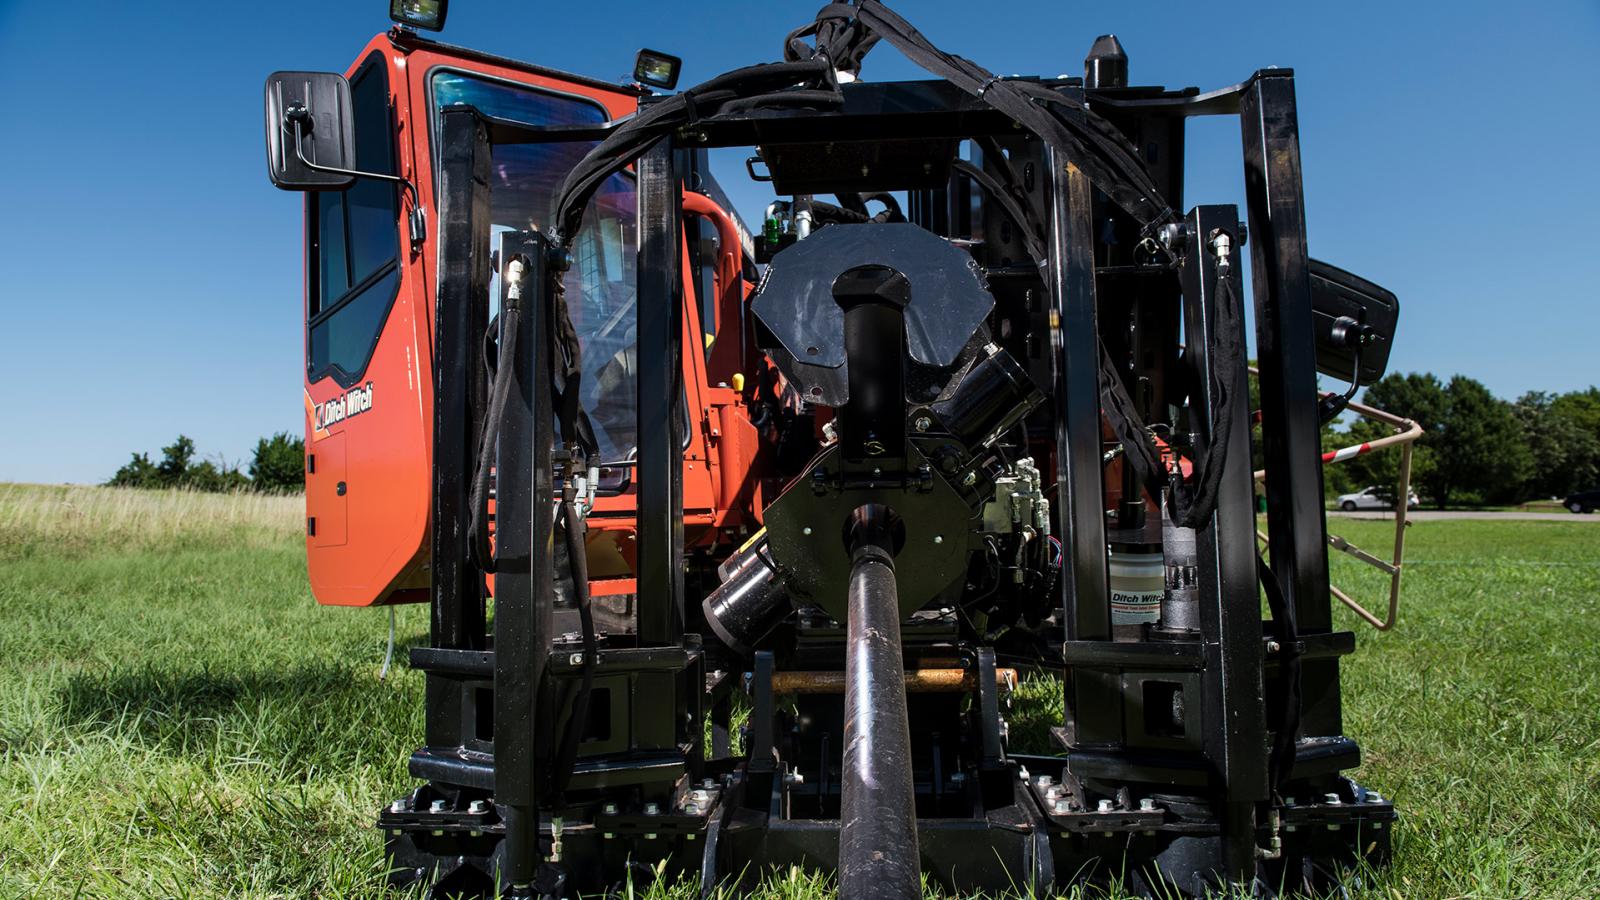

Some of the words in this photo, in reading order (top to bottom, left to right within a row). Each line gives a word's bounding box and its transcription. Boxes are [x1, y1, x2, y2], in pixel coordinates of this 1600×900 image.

[324, 394, 346, 428] Ditch
[347, 381, 373, 418] Witch
[1112, 593, 1139, 603] Ditch
[1141, 594, 1164, 603] Witc
